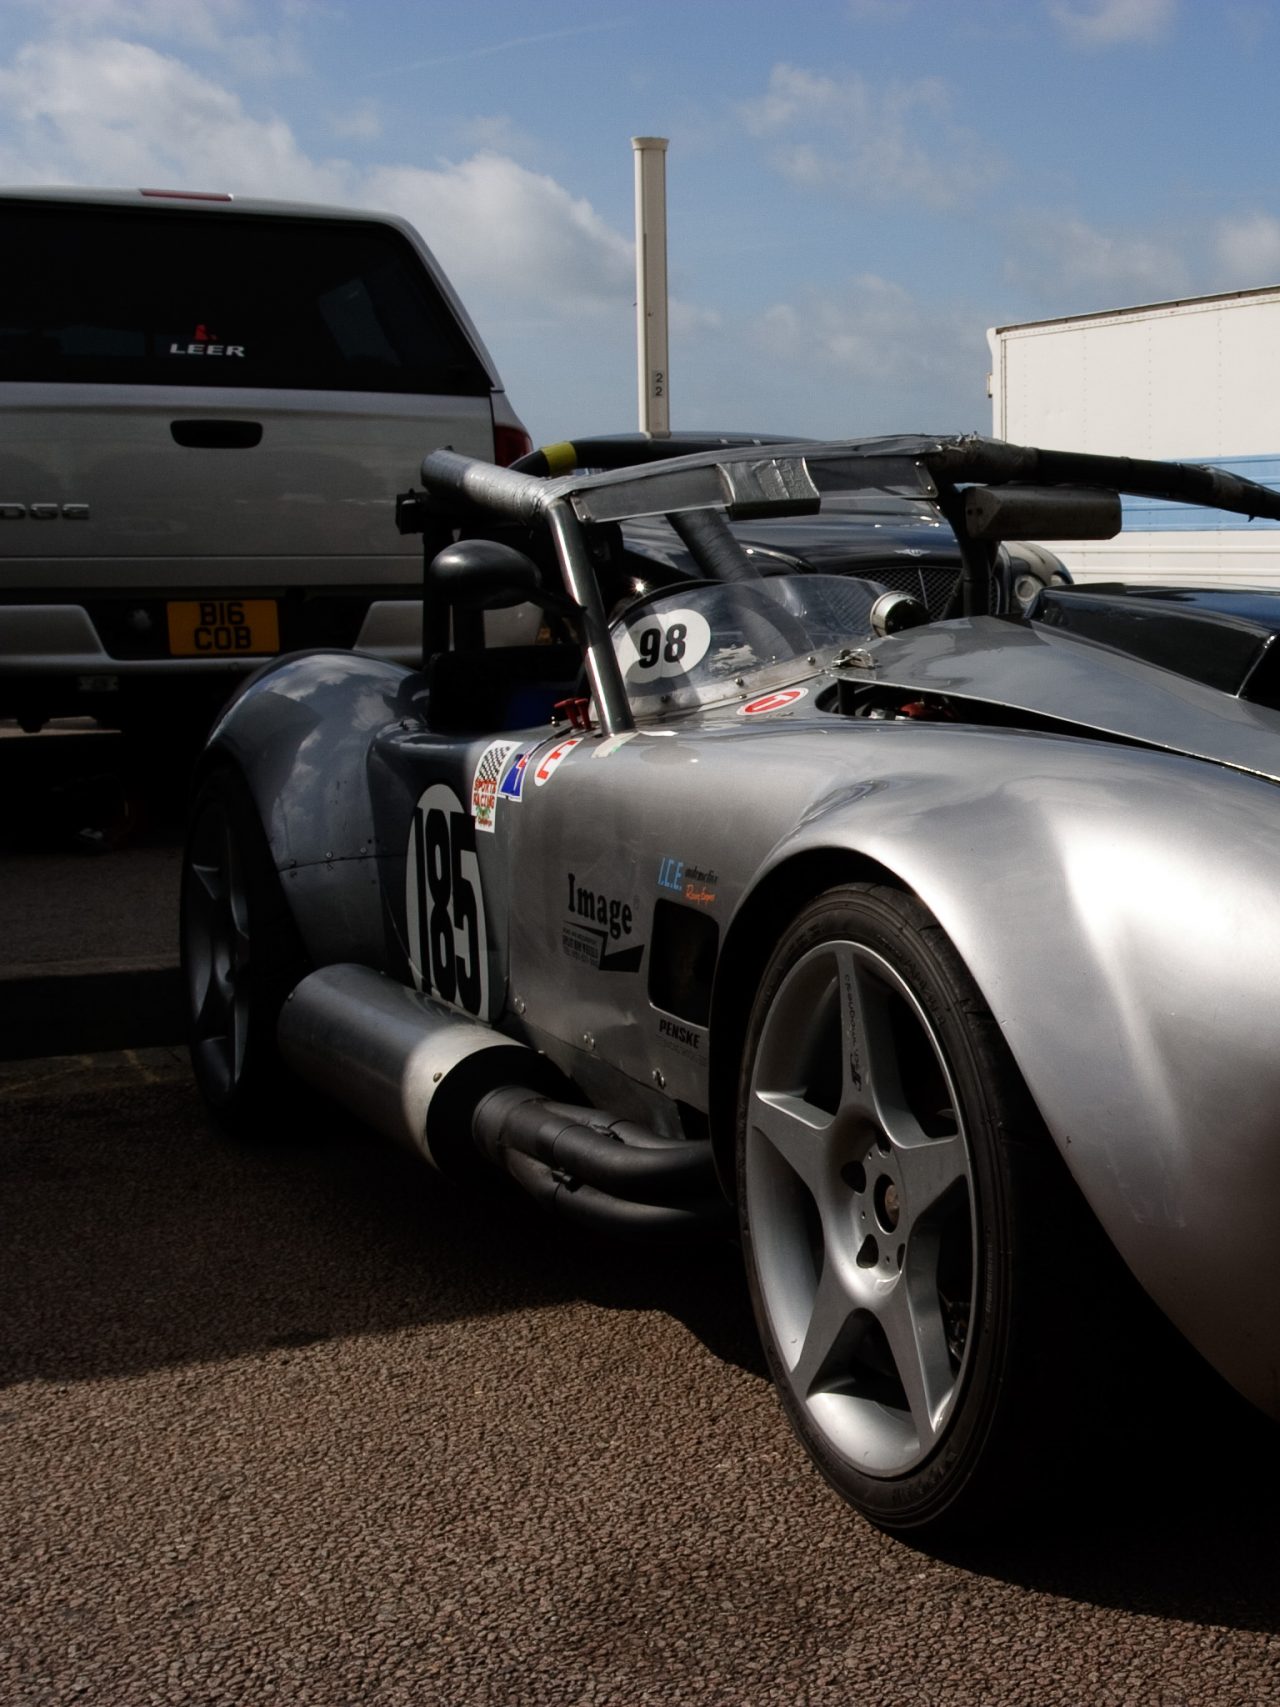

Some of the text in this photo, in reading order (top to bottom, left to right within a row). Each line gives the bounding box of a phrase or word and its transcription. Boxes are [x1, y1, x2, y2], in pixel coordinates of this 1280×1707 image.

[169, 343, 246, 358] LEER
[0, 502, 90, 521] DGE
[200, 602, 245, 626] B16
[194, 626, 251, 650] COB
[638, 623, 688, 669] 98
[415, 807, 482, 1016] 185
[567, 872, 633, 940] Image
[659, 1019, 701, 1049] PENSKE
